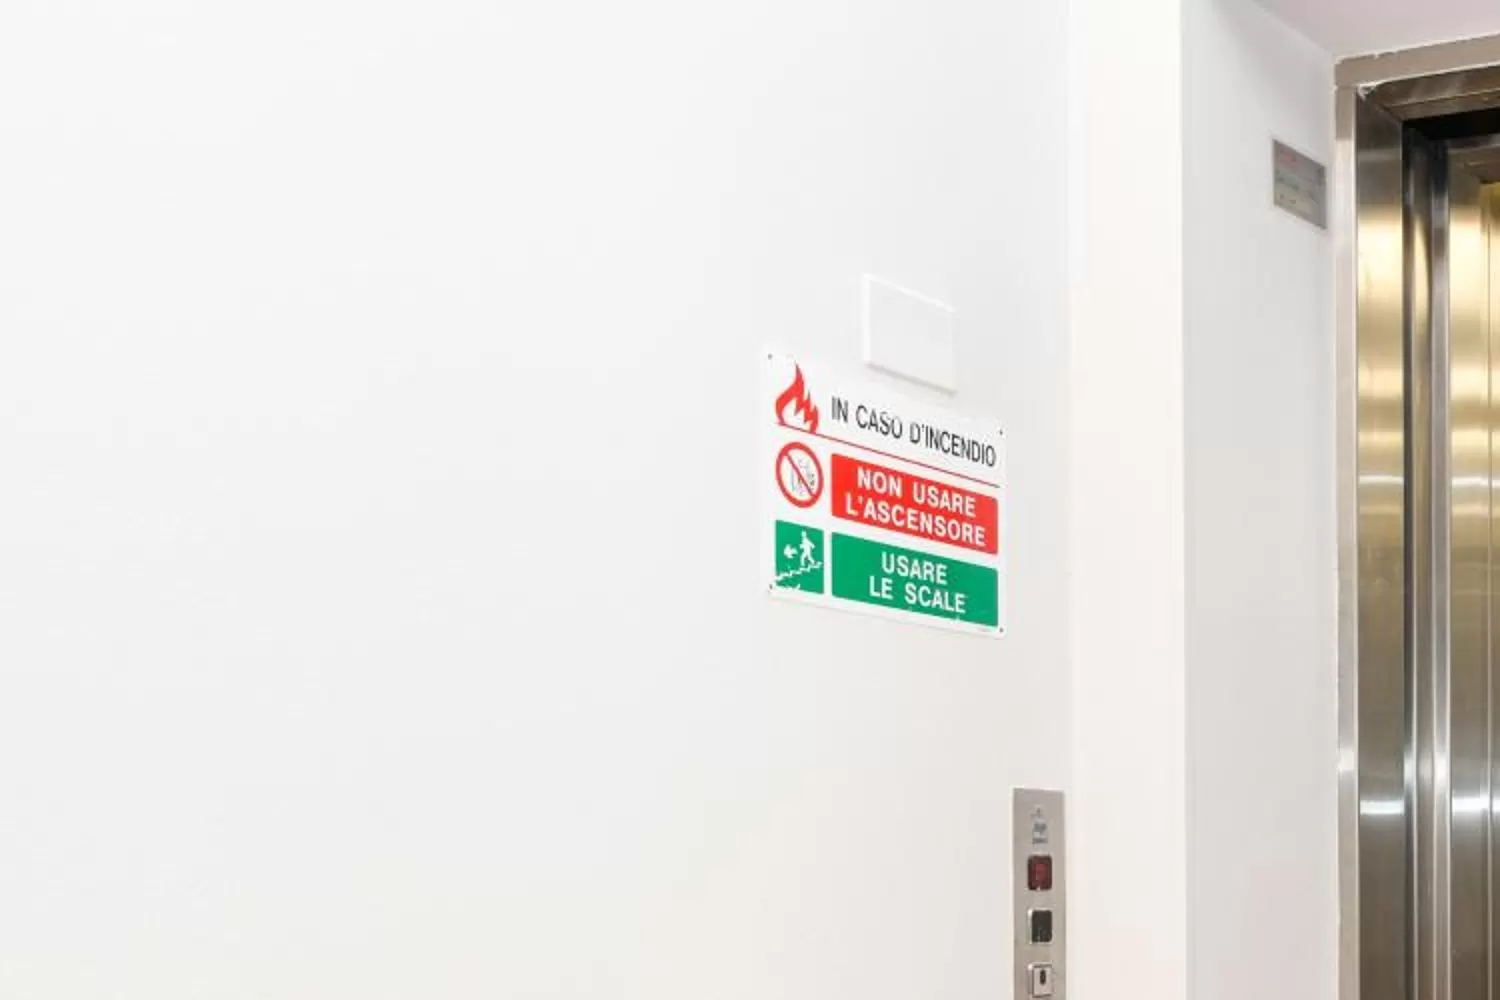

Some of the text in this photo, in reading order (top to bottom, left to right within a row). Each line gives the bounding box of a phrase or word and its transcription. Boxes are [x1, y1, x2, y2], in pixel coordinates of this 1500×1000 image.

[831, 395, 996, 466] IN CASO D'INCENDIO
[857, 466, 976, 517] NON USARE
[845, 492, 986, 546] L'ASCENSORE
[881, 551, 947, 584] USARE
[868, 575, 966, 613] LE SCALE
